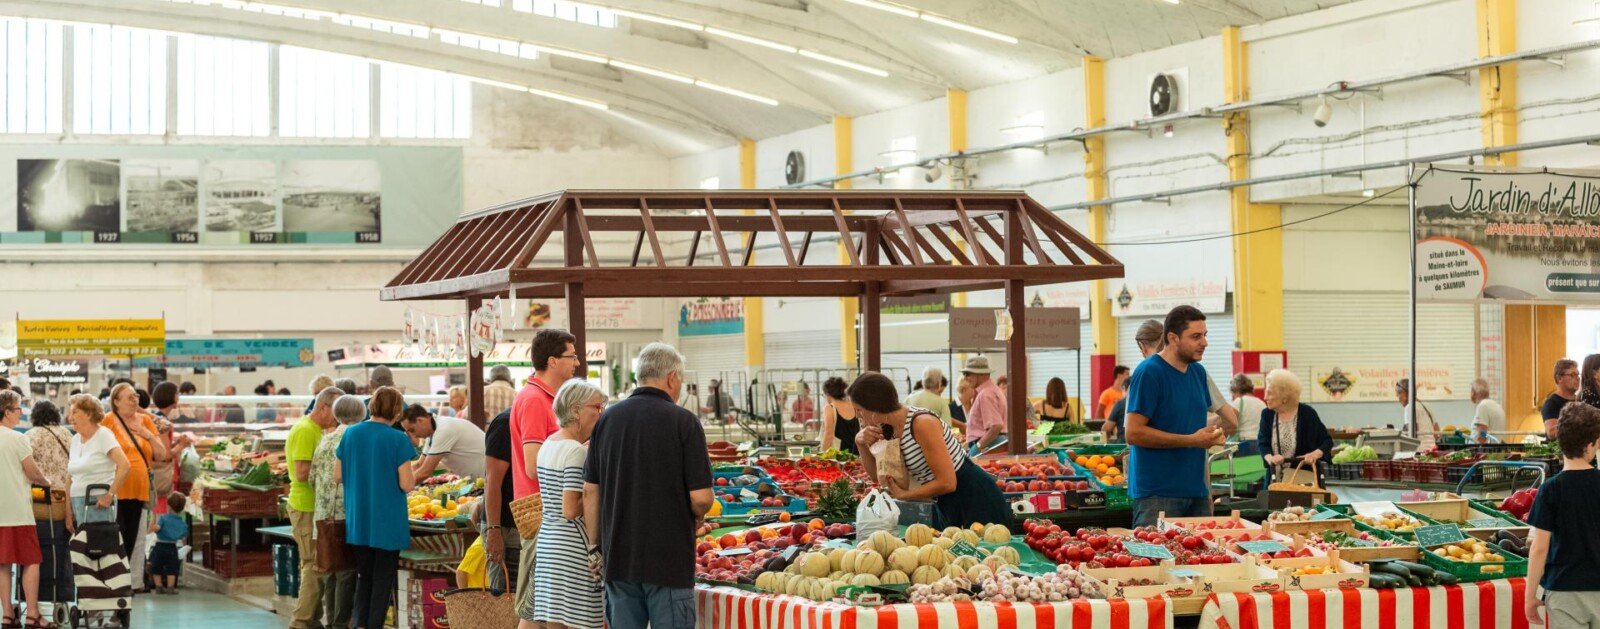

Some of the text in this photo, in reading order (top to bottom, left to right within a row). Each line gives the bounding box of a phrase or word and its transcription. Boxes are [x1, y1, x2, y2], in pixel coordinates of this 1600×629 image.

[1450, 177, 1531, 215] Jardin
[1485, 222, 1550, 238] JARDINIER,
[99, 233, 118, 241] 1937
[176, 233, 196, 241] 1956
[254, 233, 274, 241] 1957
[360, 233, 379, 241] 1958
[1429, 248, 1466, 259] situé dans le
[1540, 258, 1560, 266] Nous
[1561, 257, 1589, 266] évitons
[1418, 270, 1480, 283] à quelques kilomètres
[1434, 280, 1466, 291] de SAUMUR
[1547, 277, 1600, 289] présent que sur
[1359, 368, 1398, 378] Volailles
